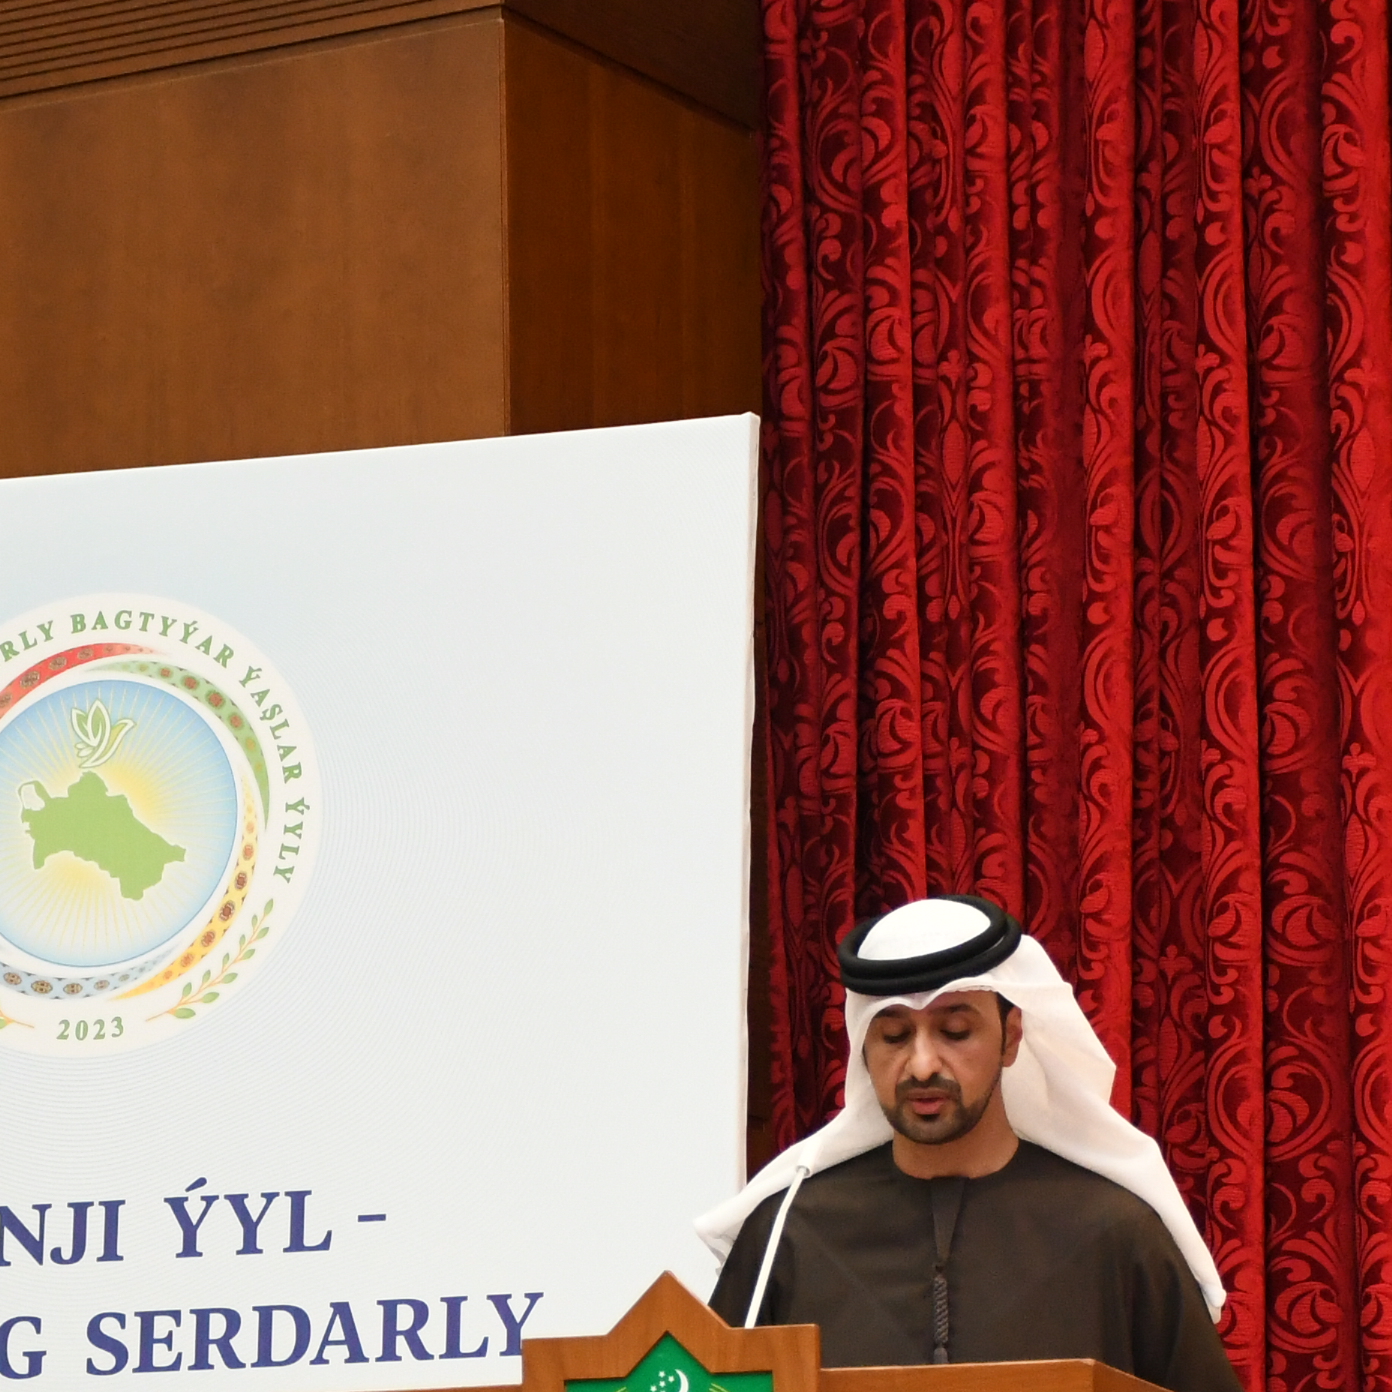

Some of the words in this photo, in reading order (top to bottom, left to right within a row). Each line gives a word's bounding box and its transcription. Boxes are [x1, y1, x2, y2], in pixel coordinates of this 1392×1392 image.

[70, 609, 235, 669] BAGTYÝAR
[238, 665, 304, 785] ÝAŞLAR
[272, 798, 311, 885] ÝYLY
[55, 1016, 125, 1041] 2023
[163, 1176, 333, 1259] ÝYL
[85, 1292, 545, 1377] SERDARLY
